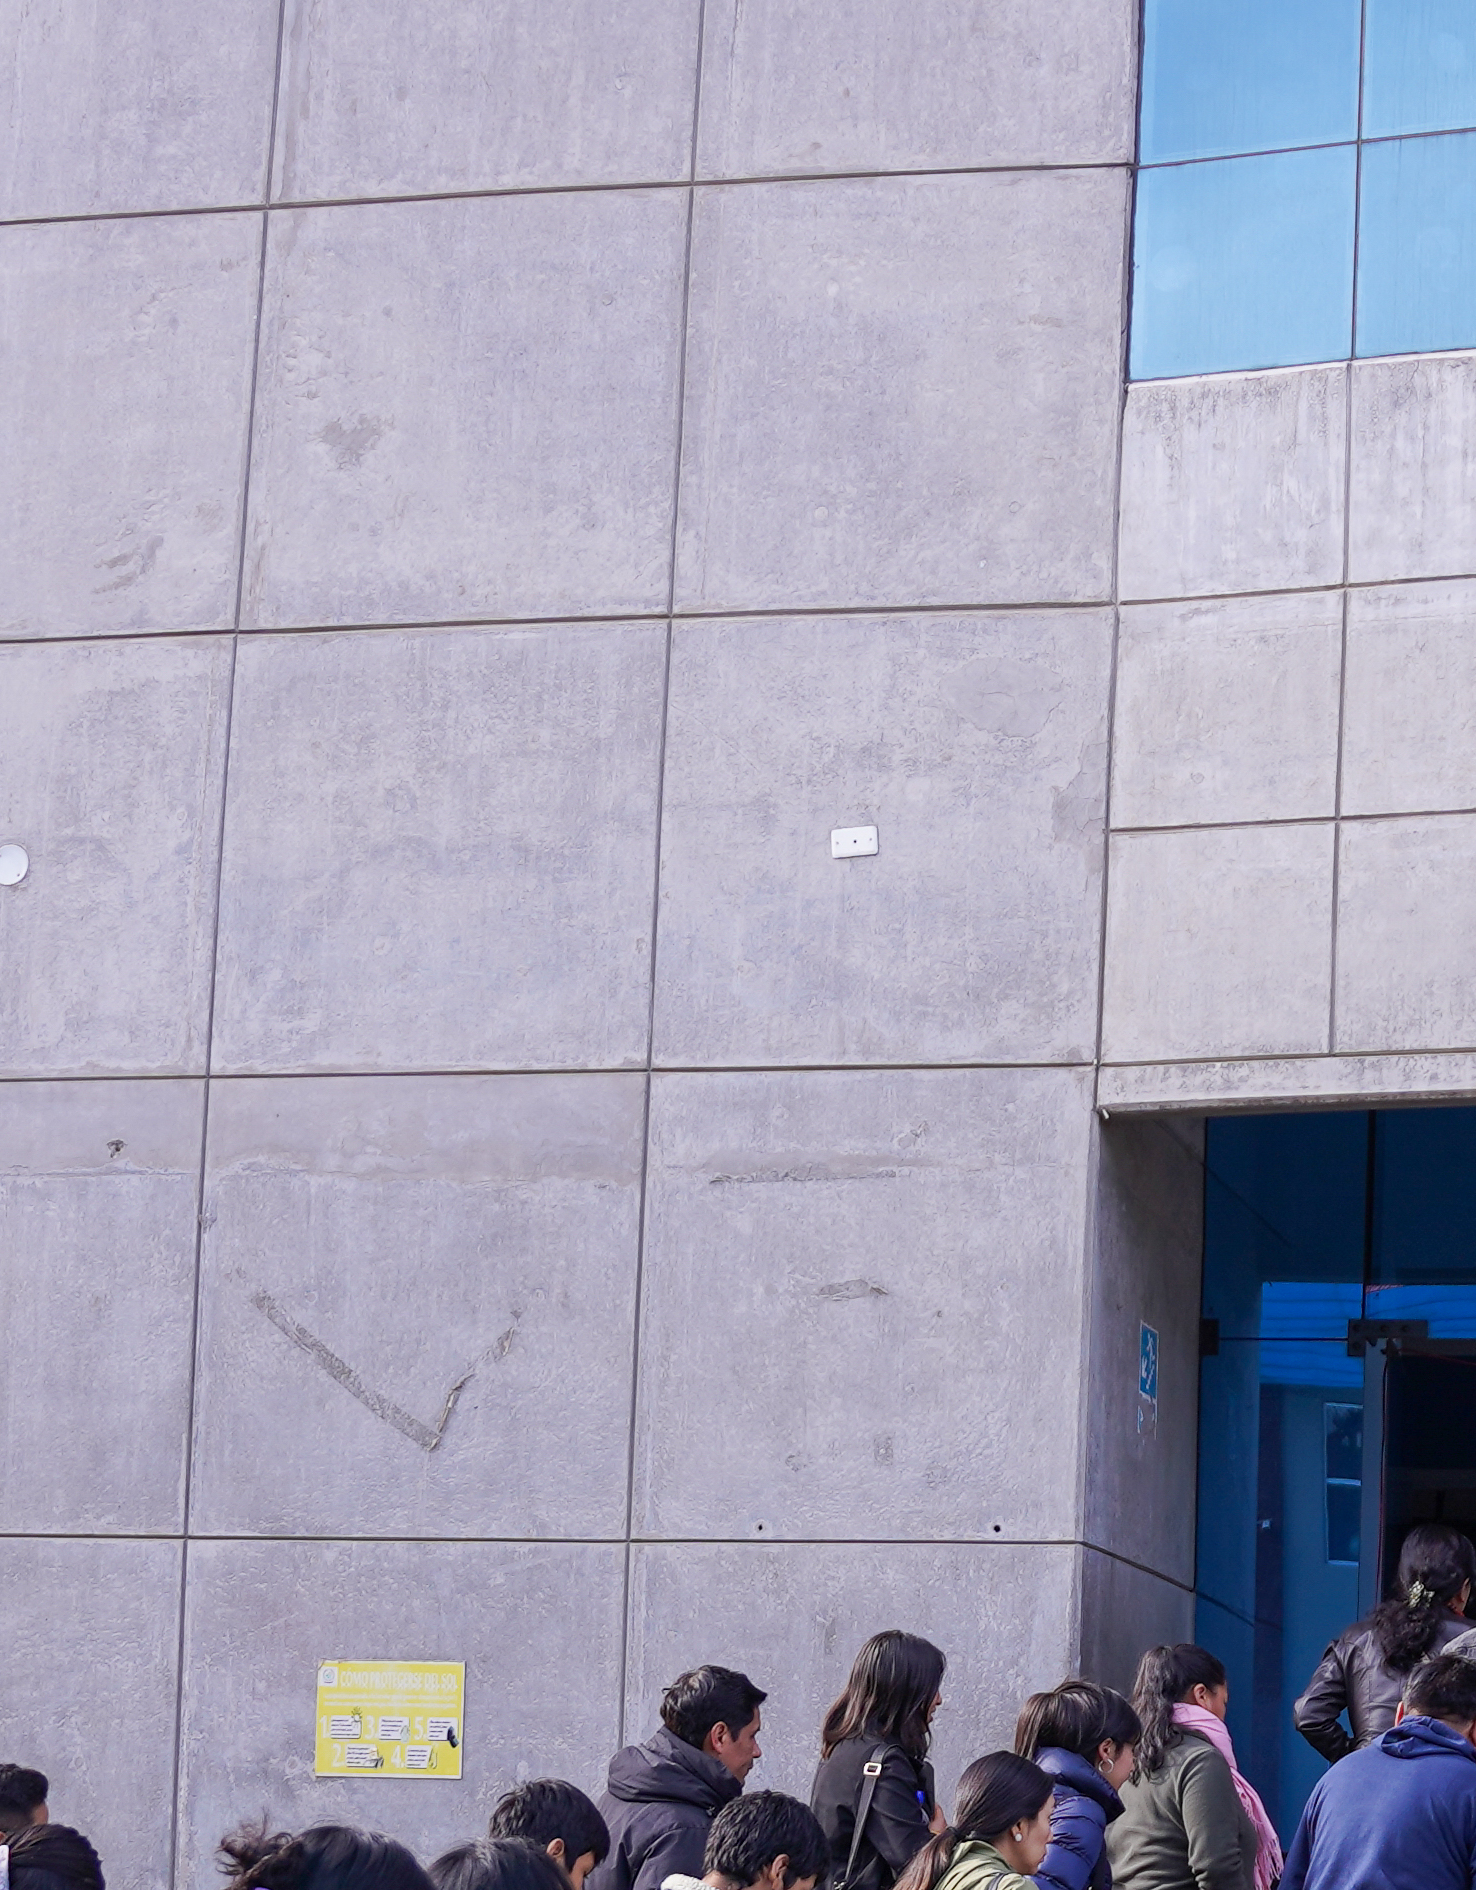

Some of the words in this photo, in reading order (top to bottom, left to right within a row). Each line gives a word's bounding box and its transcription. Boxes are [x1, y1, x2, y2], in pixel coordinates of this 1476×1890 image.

[370, 1671, 422, 1690] PROTEGERSE
[424, 1672, 440, 1692] DEL
[441, 1673, 458, 1692] SOL
